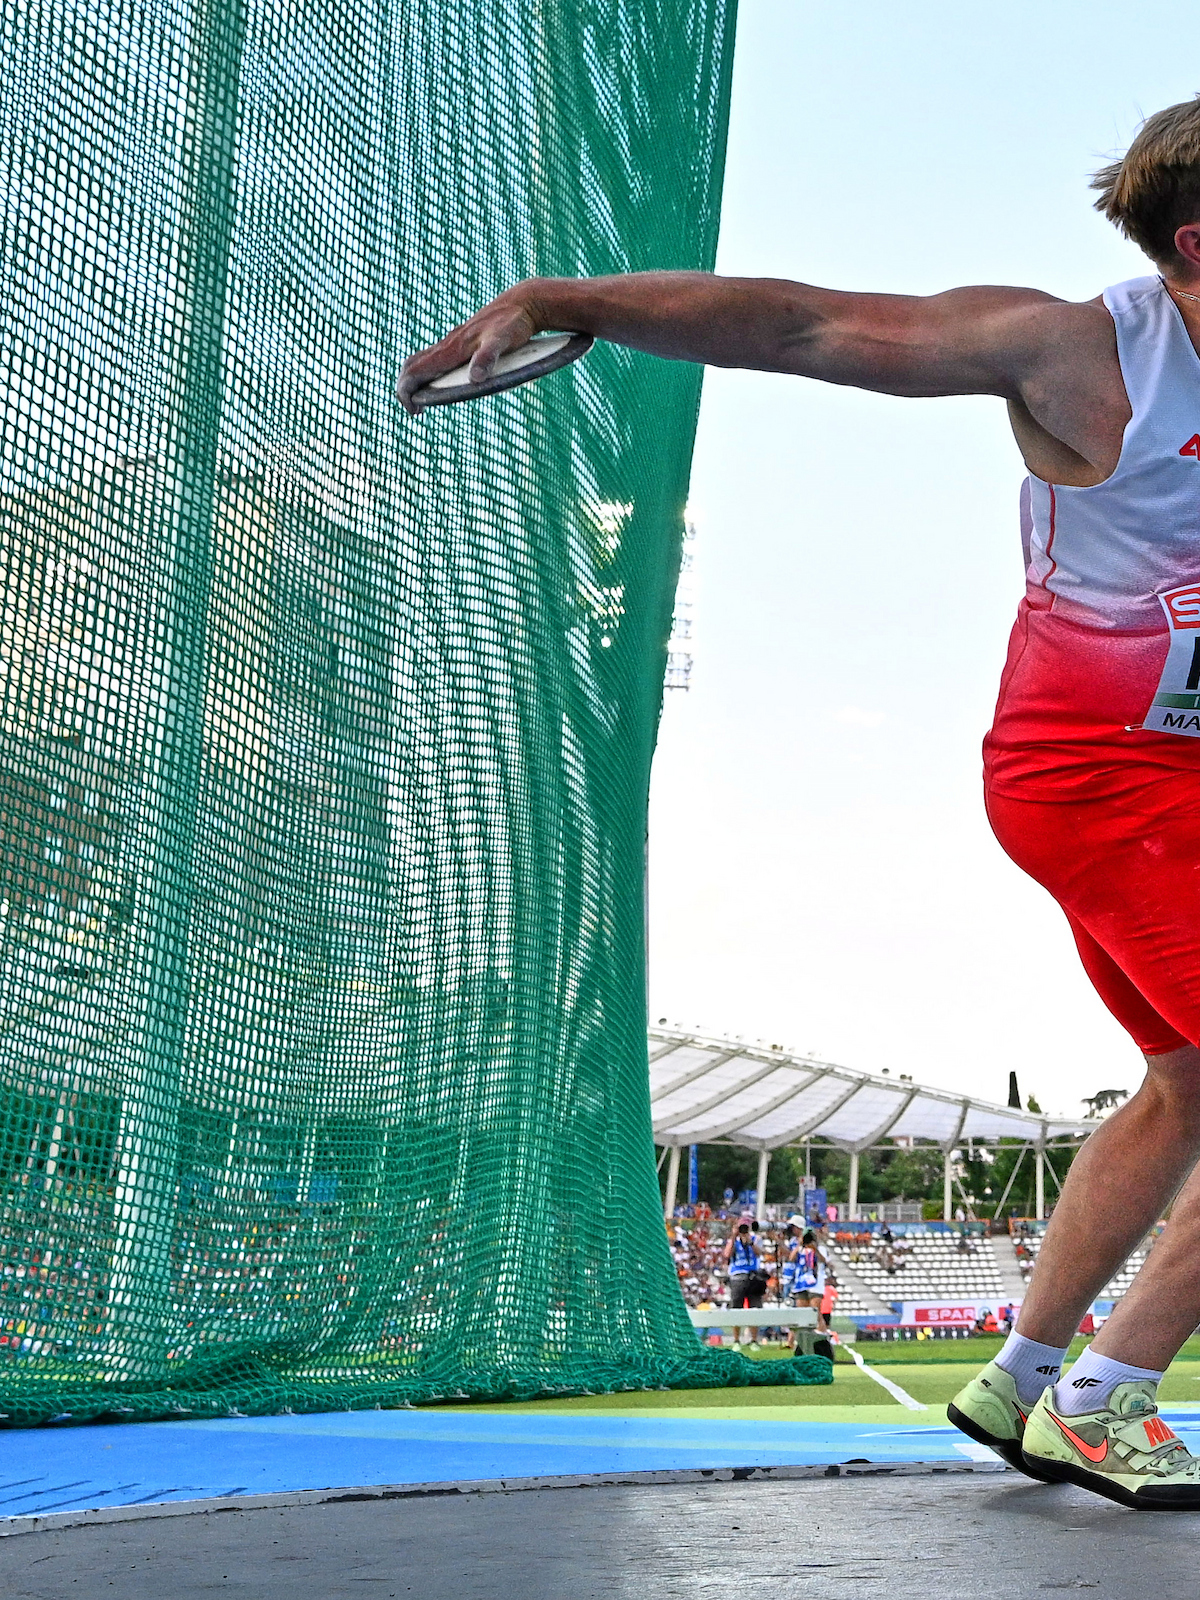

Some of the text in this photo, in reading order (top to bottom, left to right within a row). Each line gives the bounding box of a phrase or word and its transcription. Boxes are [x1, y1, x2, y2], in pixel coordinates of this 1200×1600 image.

[1193, 695, 1199, 708] I
[927, 1309, 975, 1321] SPAR
[1035, 1365, 1060, 1376] 4F
[1071, 1376, 1103, 1389] 4F
